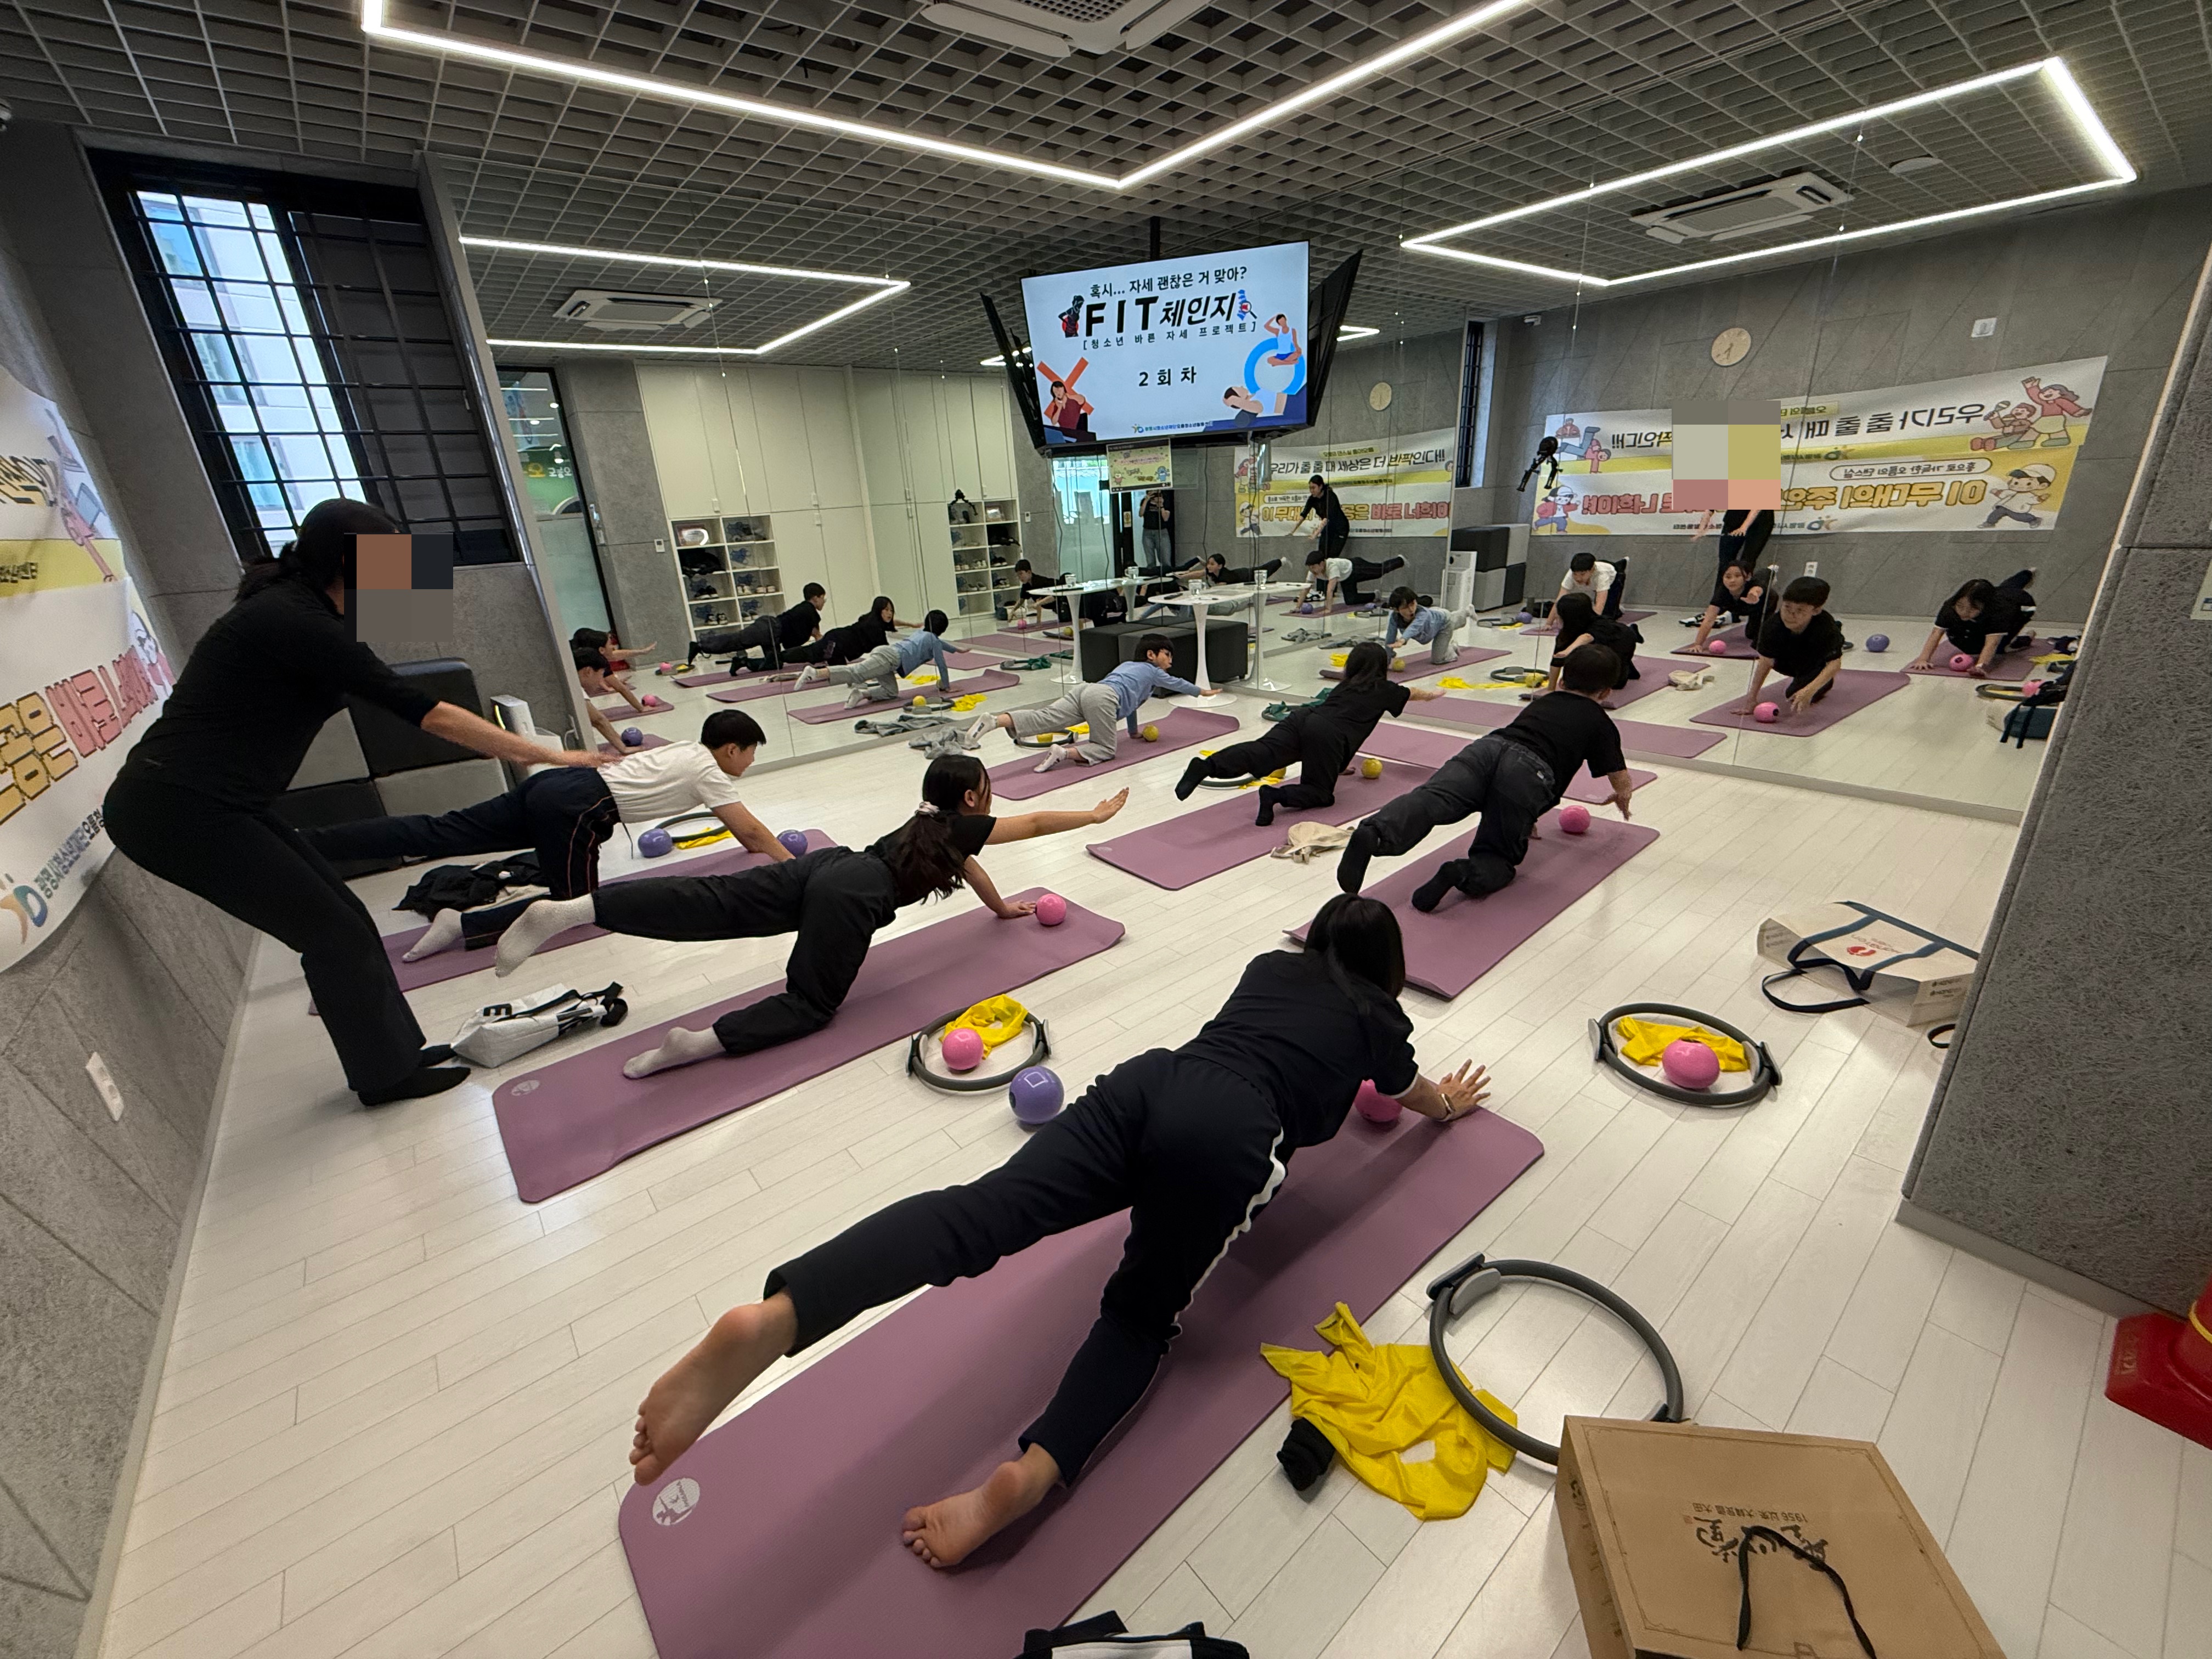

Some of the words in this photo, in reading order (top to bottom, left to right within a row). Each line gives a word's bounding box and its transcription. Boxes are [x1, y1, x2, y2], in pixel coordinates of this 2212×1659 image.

[1090, 283, 1125, 299] 혹시...
[1129, 277, 1153, 294] 자세
[1157, 272, 1194, 291] 괜찮은
[1198, 270, 1210, 285] 거
[1214, 266, 1247, 284] 맞아?
[1134, 332, 1155, 345] 바른
[1166, 329, 1188, 341] 자세
[1337, 458, 1372, 472] 세상은
[1373, 456, 1386, 468] 더
[1387, 449, 1445, 467] 반짝인다!!
[1262, 506, 1274, 522] 이
[1370, 503, 1403, 521] 바로
[1782, 1511, 1809, 1523] 1956
